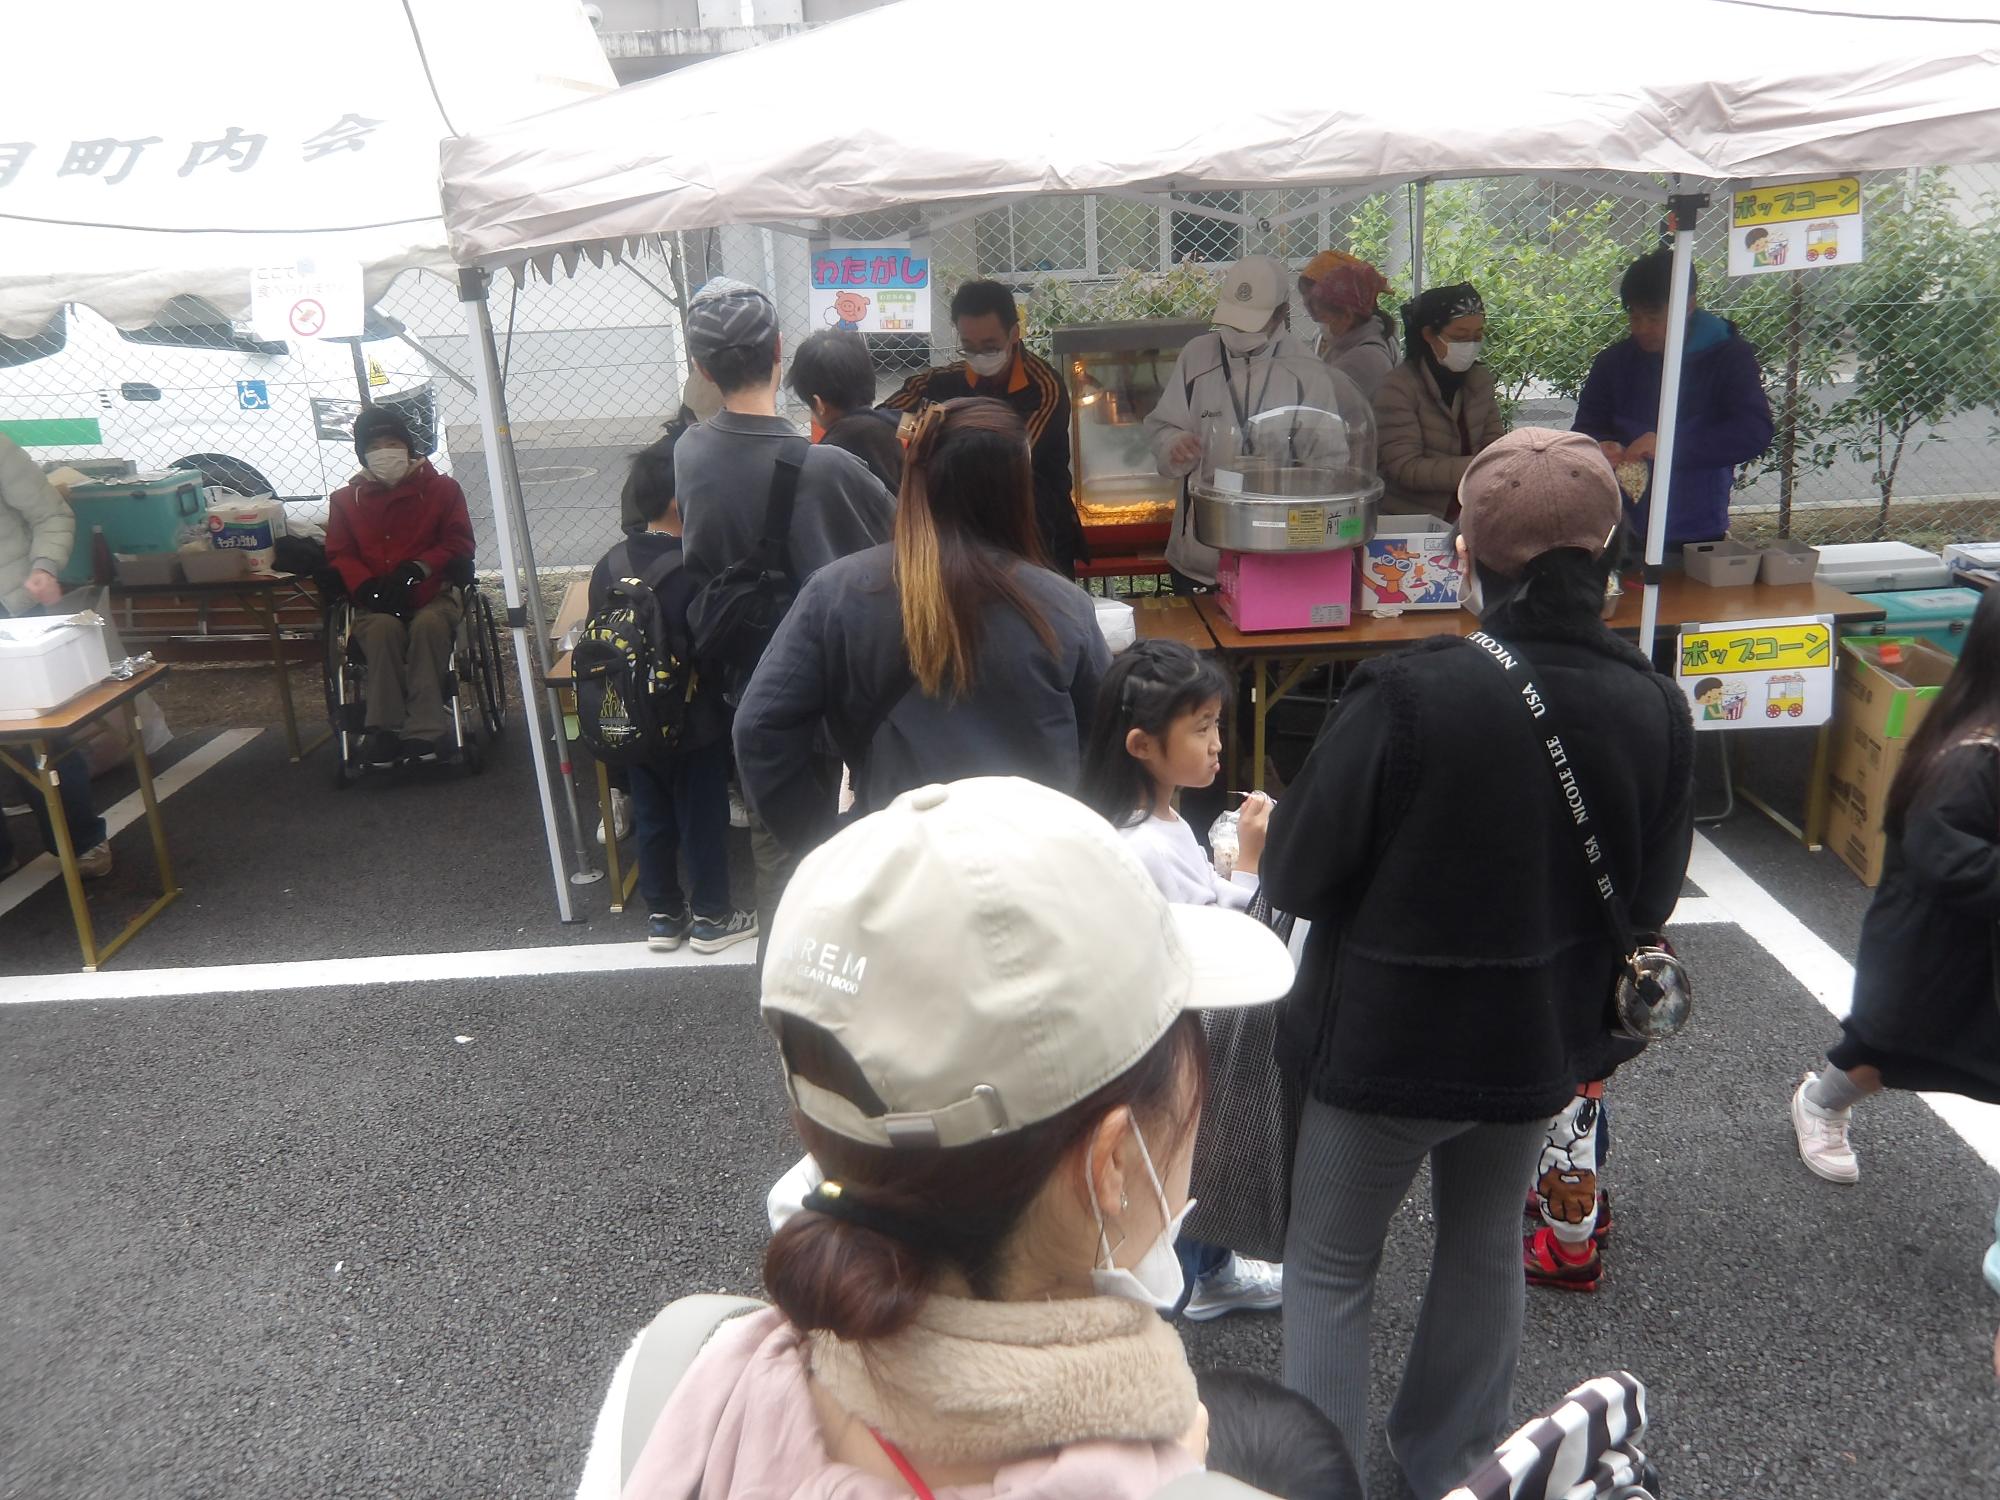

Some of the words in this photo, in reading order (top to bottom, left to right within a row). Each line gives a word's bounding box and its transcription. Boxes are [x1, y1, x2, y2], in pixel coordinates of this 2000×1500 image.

[1735, 185, 1859, 219] ポップコーン
[815, 256, 926, 285] わたがし
[1468, 631, 1518, 670] NICOLE
[1682, 633, 1829, 667] ポップコーン
[1522, 683, 1545, 718] USA
[1546, 736, 1567, 767] LEE
[1559, 767, 1588, 824] NICOLE
[1584, 835, 1601, 864] USA
[1597, 874, 1614, 899] LEE
